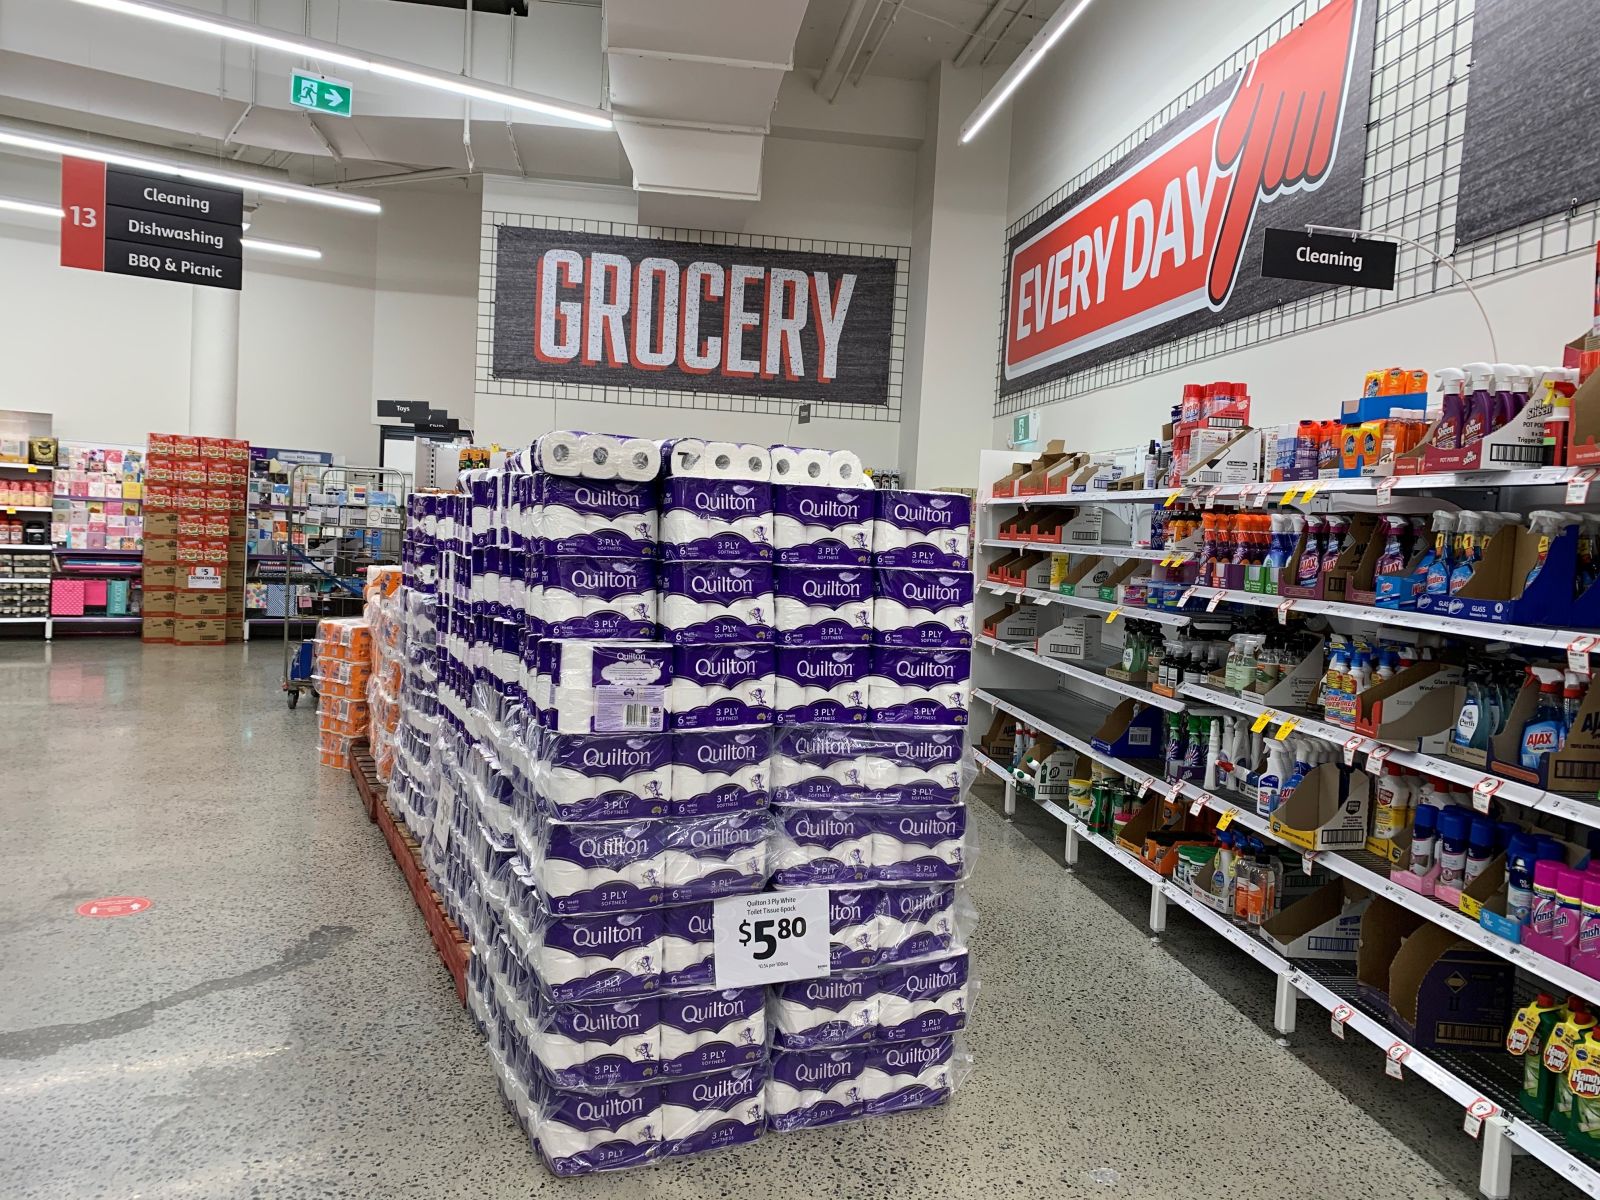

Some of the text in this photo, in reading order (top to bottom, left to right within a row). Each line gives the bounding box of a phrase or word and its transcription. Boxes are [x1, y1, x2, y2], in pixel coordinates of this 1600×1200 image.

[144, 188, 210, 213] Cleaning
[70, 206, 96, 228] 13
[129, 220, 223, 249] Dishwashing
[1017, 166, 1215, 341] EVERY DAY
[1297, 247, 1362, 271] Cleaning
[129, 253, 222, 278] BBQ & Picnic
[534, 249, 856, 383] GROCERY
[1527, 405, 1553, 419] Sheen
[575, 488, 640, 507] Quilton
[695, 492, 755, 511] Quilton
[800, 499, 858, 517] Quilton
[895, 504, 950, 522] Quilton
[557, 542, 564, 550] 6
[781, 551, 787, 560] 6
[572, 570, 636, 589] Quilton
[692, 576, 752, 594] Quilton
[803, 580, 860, 598] Quilton
[903, 583, 959, 600] Quilton
[617, 653, 645, 661] Quilton
[696, 659, 755, 676] Quilton
[797, 660, 853, 678] Quilton
[897, 661, 953, 678] Quilton
[678, 716, 684, 725] 6
[1526, 733, 1552, 746] AJAX
[584, 748, 650, 767] Quilton
[698, 745, 755, 763] Quilton
[895, 742, 952, 759] Quilton
[796, 821, 854, 837] Quilton
[900, 818, 956, 836] Quilton
[691, 829, 750, 848] Quilton
[579, 838, 648, 858] Quilton
[559, 900, 565, 909] 6
[610, 891, 627, 900] PLY
[831, 904, 861, 920] lton
[573, 926, 642, 947] Quilton
[807, 982, 862, 1000] Quilton
[907, 972, 957, 992] Quilton
[682, 1000, 744, 1023] Quilton
[573, 1014, 639, 1032] Quilton
[1511, 1031, 1527, 1040] Handy
[711, 1050, 726, 1059] PLY
[1511, 1040, 1525, 1052] Andy
[1548, 1046, 1568, 1059] Handy
[887, 1048, 940, 1066] Quilton
[1548, 1056, 1565, 1070] Andy
[796, 1062, 851, 1081] Quilton
[693, 1079, 752, 1101] Quilton
[1576, 1082, 1600, 1094] Andy
[577, 1098, 643, 1120] Quilton
